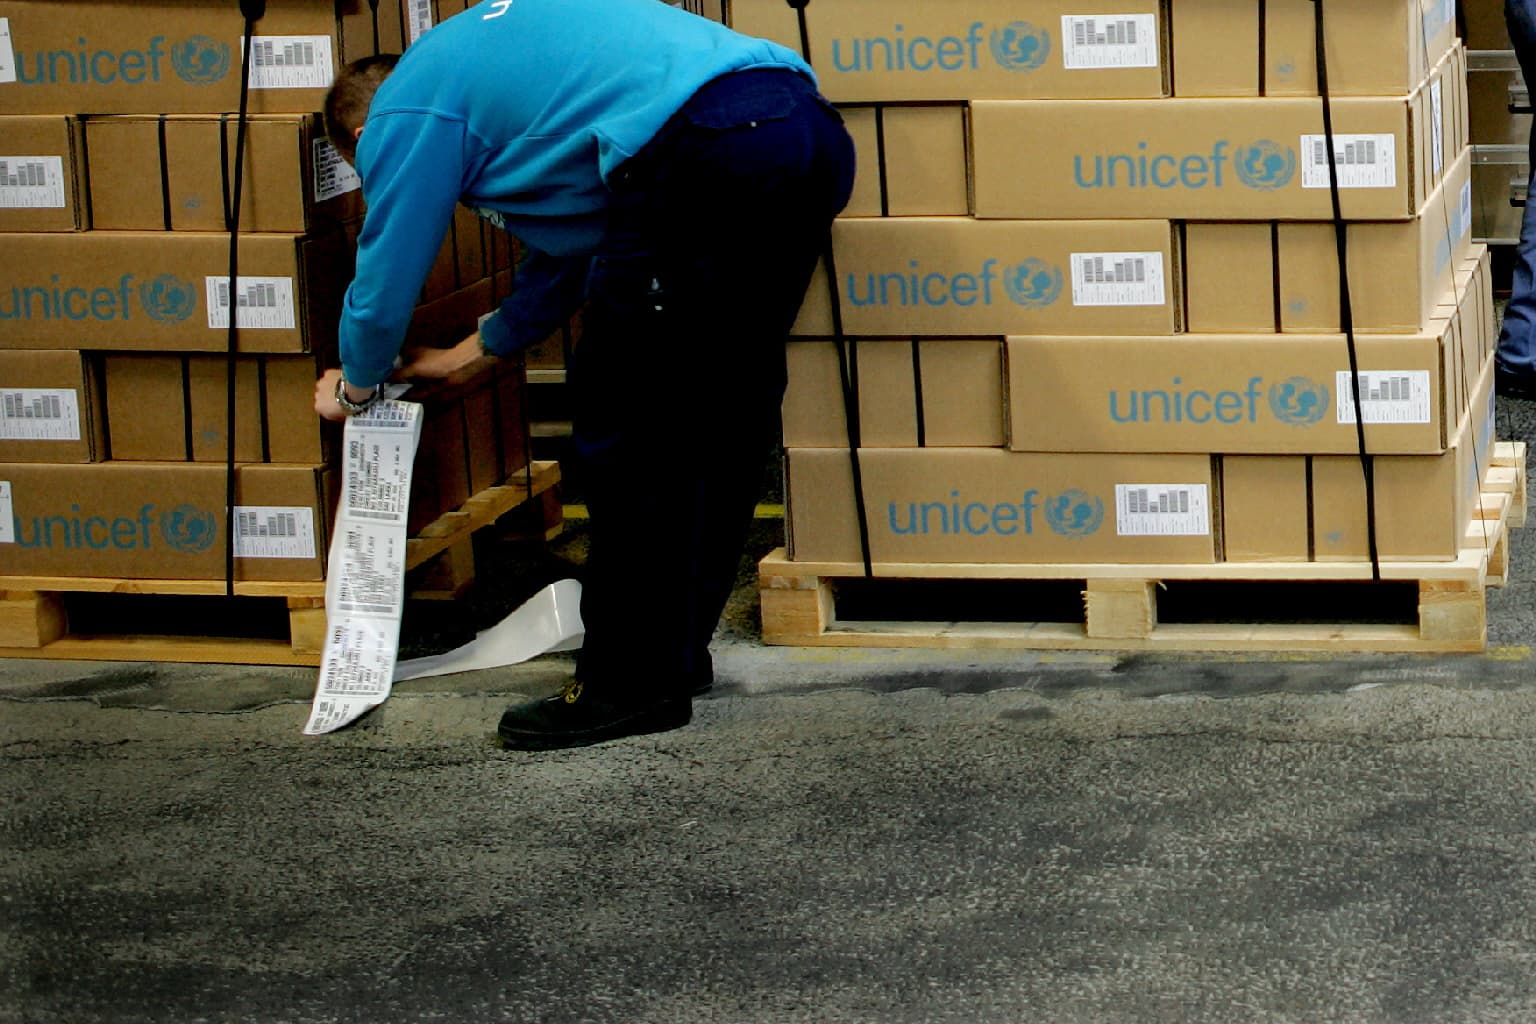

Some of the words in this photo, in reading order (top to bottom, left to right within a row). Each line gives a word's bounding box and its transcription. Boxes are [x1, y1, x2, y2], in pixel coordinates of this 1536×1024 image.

[16, 34, 165, 84] unicef
[831, 22, 983, 73] unicef
[1073, 140, 1227, 189] unicef
[846, 259, 997, 307] unicef
[1109, 376, 1263, 425] unicef
[14, 503, 154, 550] unicef
[888, 489, 1037, 536] unicef
